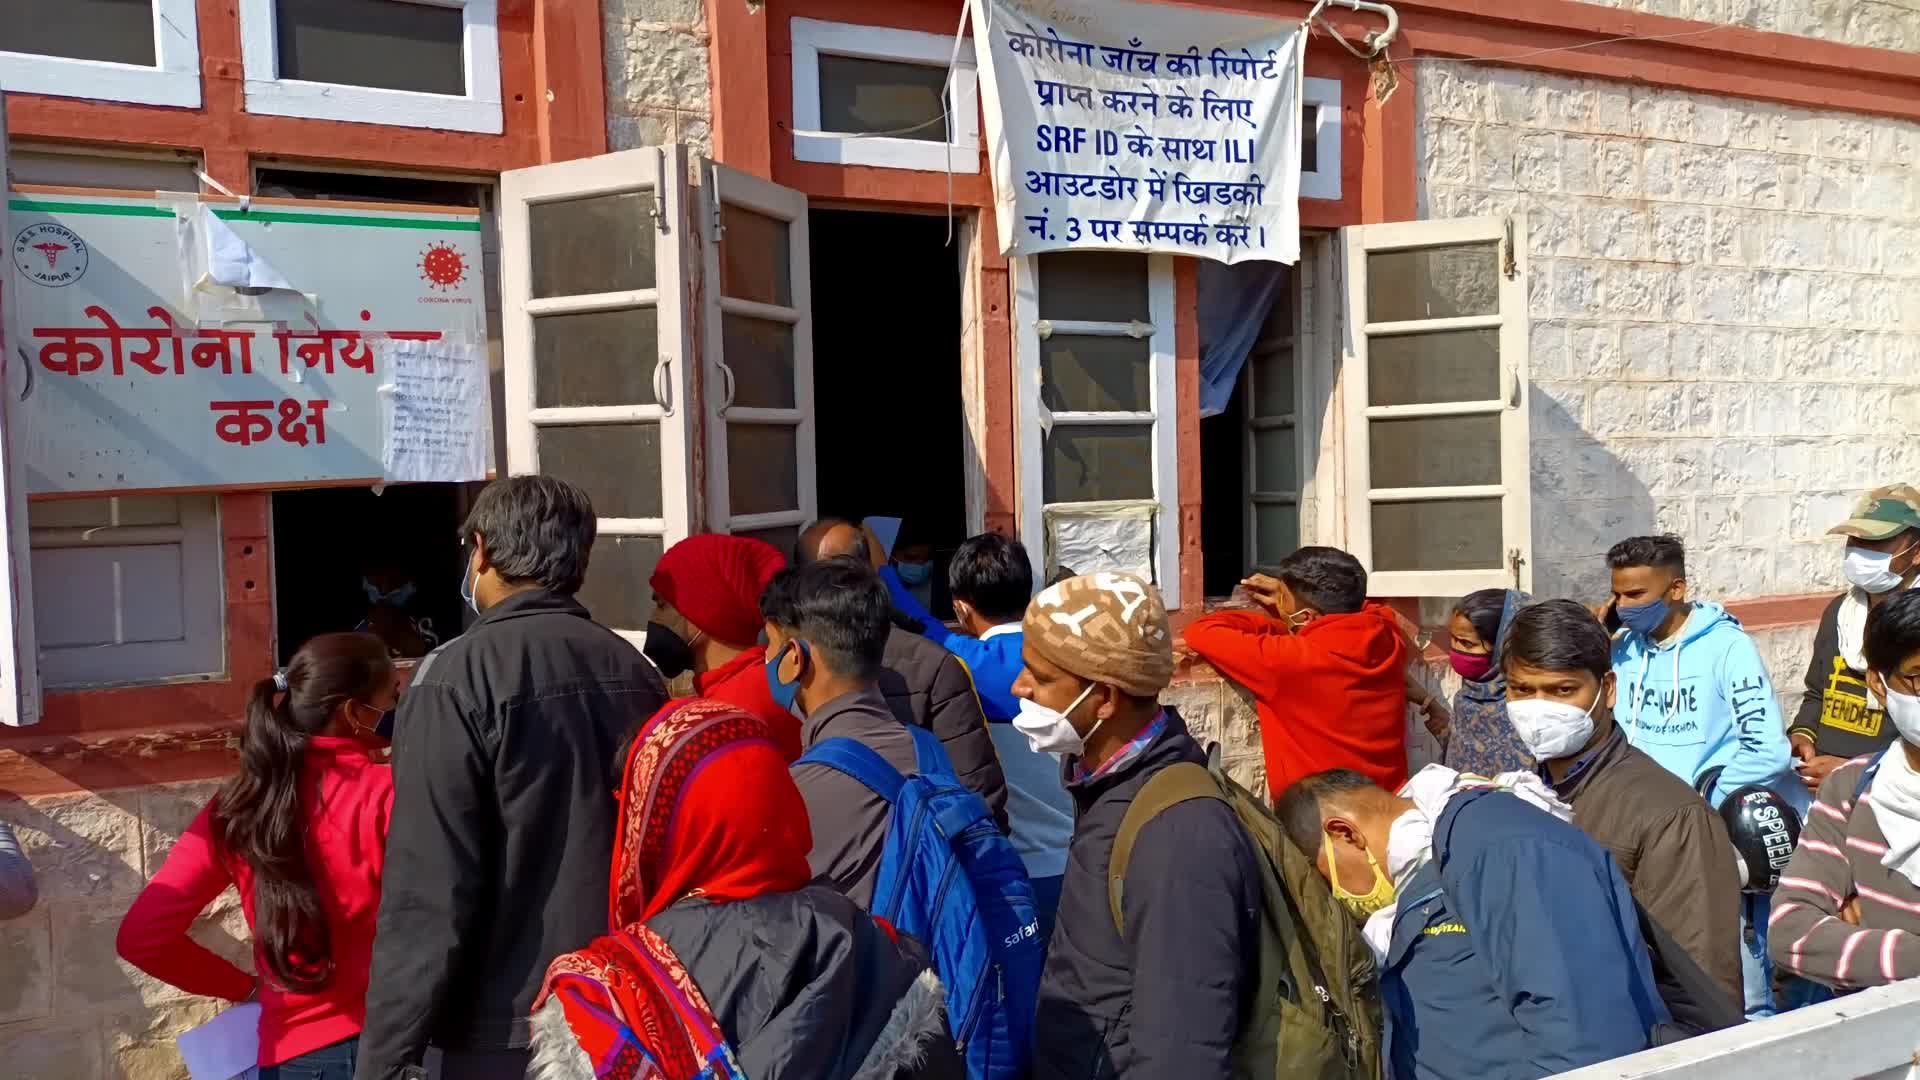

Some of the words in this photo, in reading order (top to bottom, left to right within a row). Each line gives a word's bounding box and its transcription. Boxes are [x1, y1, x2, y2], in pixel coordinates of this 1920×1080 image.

[1005, 23, 1095, 67] कोरोना
[1099, 37, 1160, 75] जाँच
[1165, 46, 1203, 78] की
[1207, 47, 1278, 81] रिपोर्ट
[1034, 79, 1093, 110] प्राप्त
[1097, 82, 1160, 117] करने
[1165, 85, 1194, 119] के
[1199, 88, 1257, 129] लिए
[1036, 124, 1086, 154] SRF
[1095, 129, 1118, 156] ID
[1123, 124, 1153, 158] के
[1157, 137, 1216, 164] साथ
[1225, 138, 1255, 164] ILI
[1024, 165, 1139, 202] आउटडोर
[1143, 167, 1168, 202] में
[39, 226, 84, 255] HOSPITAL
[1065, 217, 1082, 242] 3
[1088, 219, 1123, 243] पर
[1127, 213, 1209, 246] सम्पर्क
[33, 271, 72, 282] JAIPUR
[417, 296, 450, 304] CORONA
[33, 305, 256, 376] कोरोना
[210, 398, 329, 448] कक्ष
[1752, 805, 1793, 871] SPEED
[1004, 916, 1040, 949] safari
